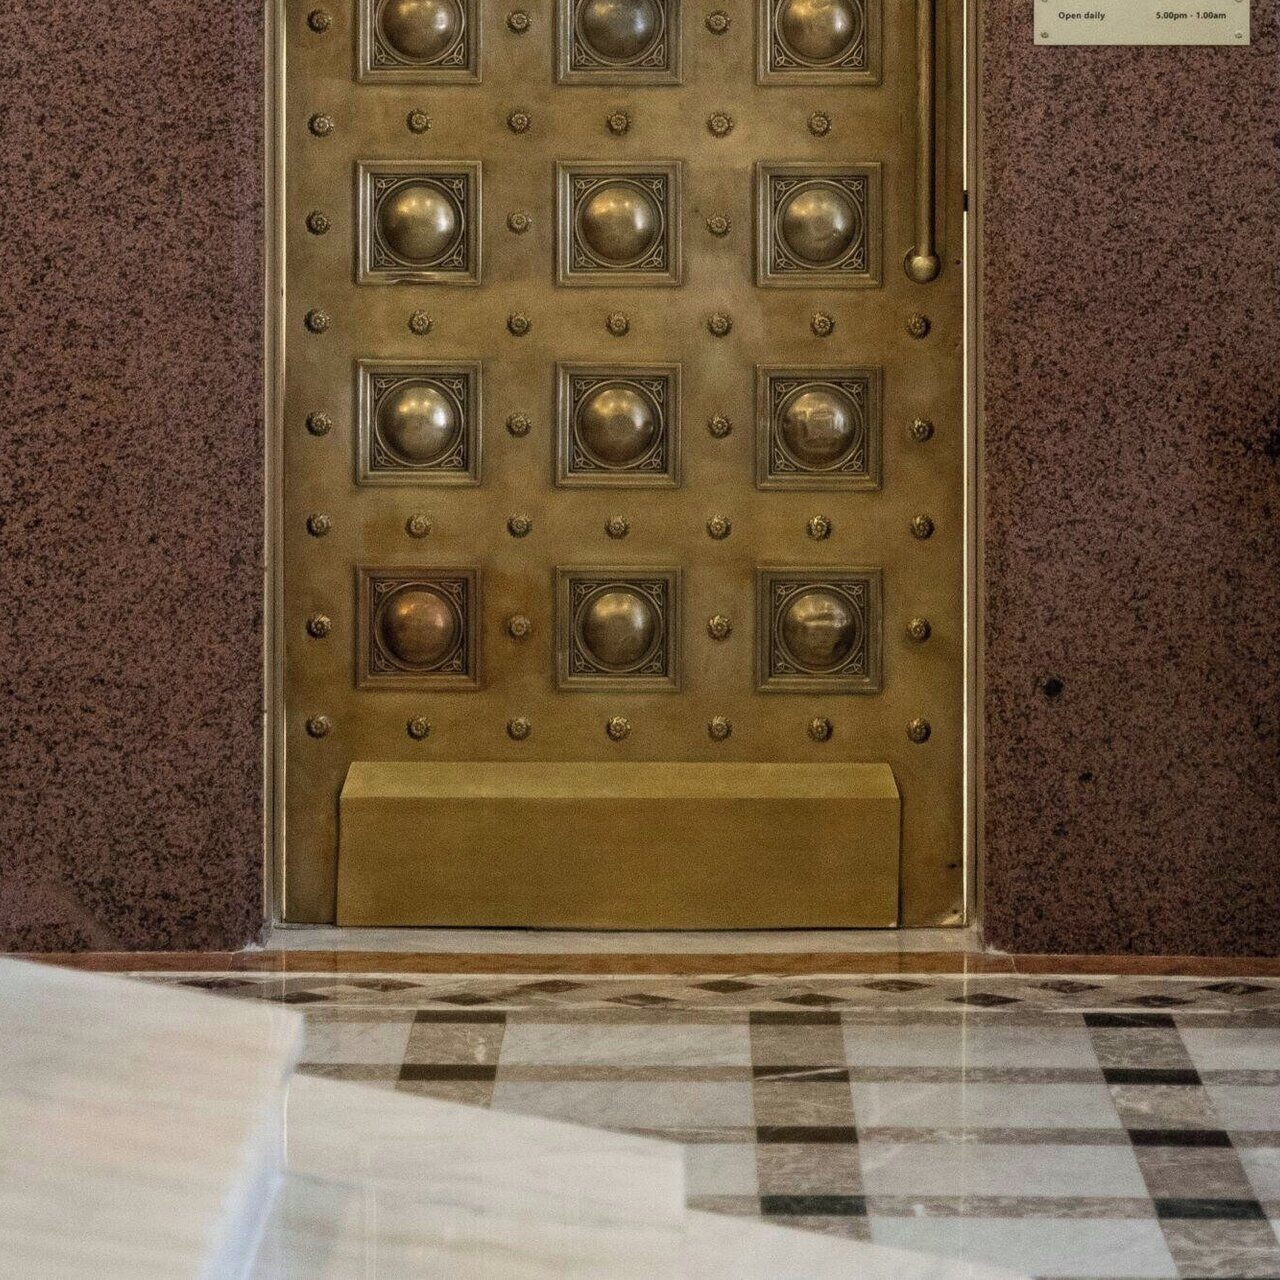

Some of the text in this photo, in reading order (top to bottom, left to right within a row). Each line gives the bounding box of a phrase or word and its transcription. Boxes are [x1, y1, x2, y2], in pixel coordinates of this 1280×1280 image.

[1057, 11, 1082, 21] Open
[1083, 10, 1106, 21] daily
[1155, 11, 1188, 21] 5.00pm
[1195, 11, 1227, 20] 1.00am
